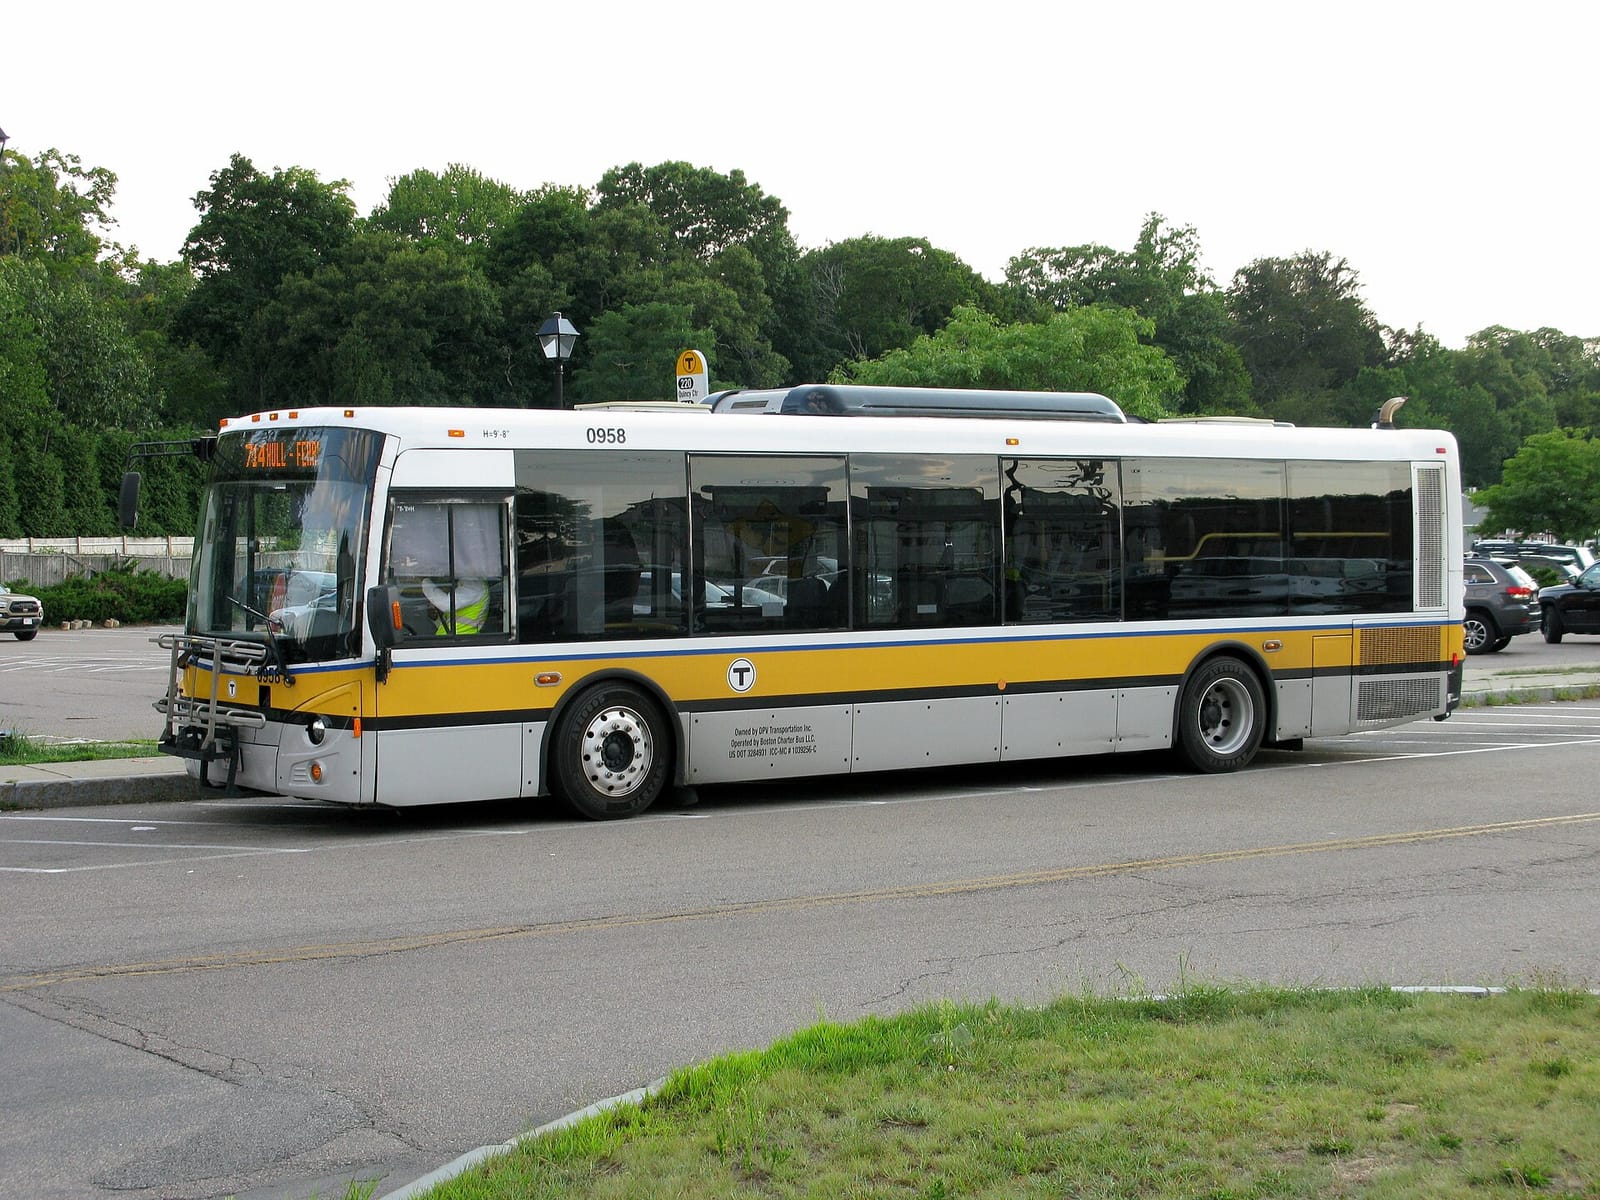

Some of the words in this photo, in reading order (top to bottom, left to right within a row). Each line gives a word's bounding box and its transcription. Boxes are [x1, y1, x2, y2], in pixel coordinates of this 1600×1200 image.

[684, 357, 694, 370] T
[680, 378, 692, 389] 220
[586, 427, 626, 444] 0958
[266, 442, 287, 467] HULL
[733, 667, 750, 686] T
[230, 683, 235, 695] T
[735, 727, 751, 736] Owned
[752, 727, 758, 737] by
[759, 726, 768, 735] DPV
[769, 724, 802, 735] Transportation
[731, 738, 752, 748] Operated
[753, 738, 759, 747] by
[760, 736, 776, 746] Boston
[777, 735, 794, 745] Charter
[795, 735, 804, 743] Bus
[729, 750, 735, 759] US
[736, 749, 746, 758] DOT
